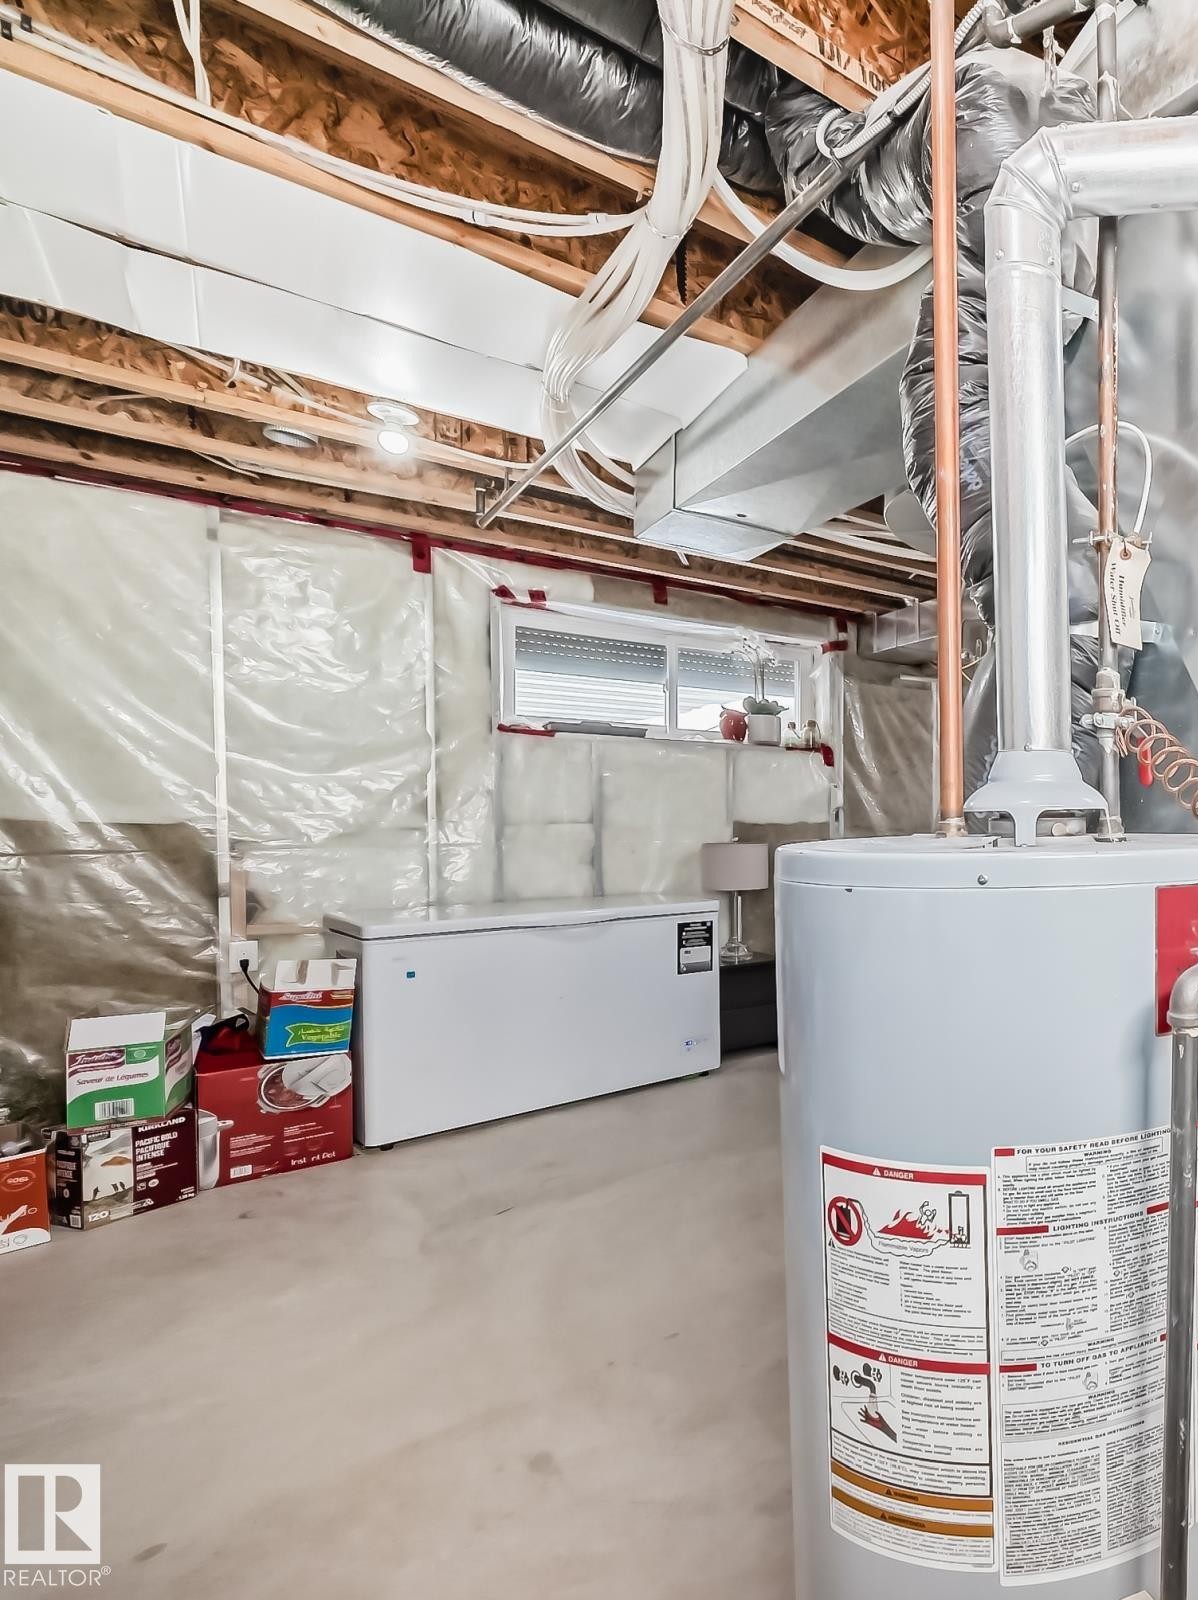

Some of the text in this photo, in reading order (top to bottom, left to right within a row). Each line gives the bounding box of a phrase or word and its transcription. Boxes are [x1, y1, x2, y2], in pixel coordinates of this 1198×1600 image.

[76, 1078, 103, 1086] Saveur
[135, 1137, 160, 1148] PACIFIC
[1035, 1146, 1056, 1154] YOUR
[1059, 1143, 1087, 1152] SAFETY
[1090, 1140, 1110, 1148] READ
[1111, 1135, 1139, 1145] BEFORE
[1140, 1128, 1171, 1140] LIGHTING
[136, 1141, 170, 1155] PACIFIQUE
[136, 1150, 164, 1162] INTENSE
[883, 1170, 913, 1179] DANGER
[1053, 1211, 1144, 1232] LIGHTING INSTRUCTIONS
[1087, 1338, 1114, 1347] WARNING
[1054, 1359, 1074, 1367] TURN
[1076, 1356, 1089, 1364] OFF
[1092, 1352, 1107, 1360] GAS
[1120, 1337, 1157, 1353] APPLIANCE
[888, 1356, 918, 1367] DANGER
[1088, 1390, 1115, 1399] WARNING
